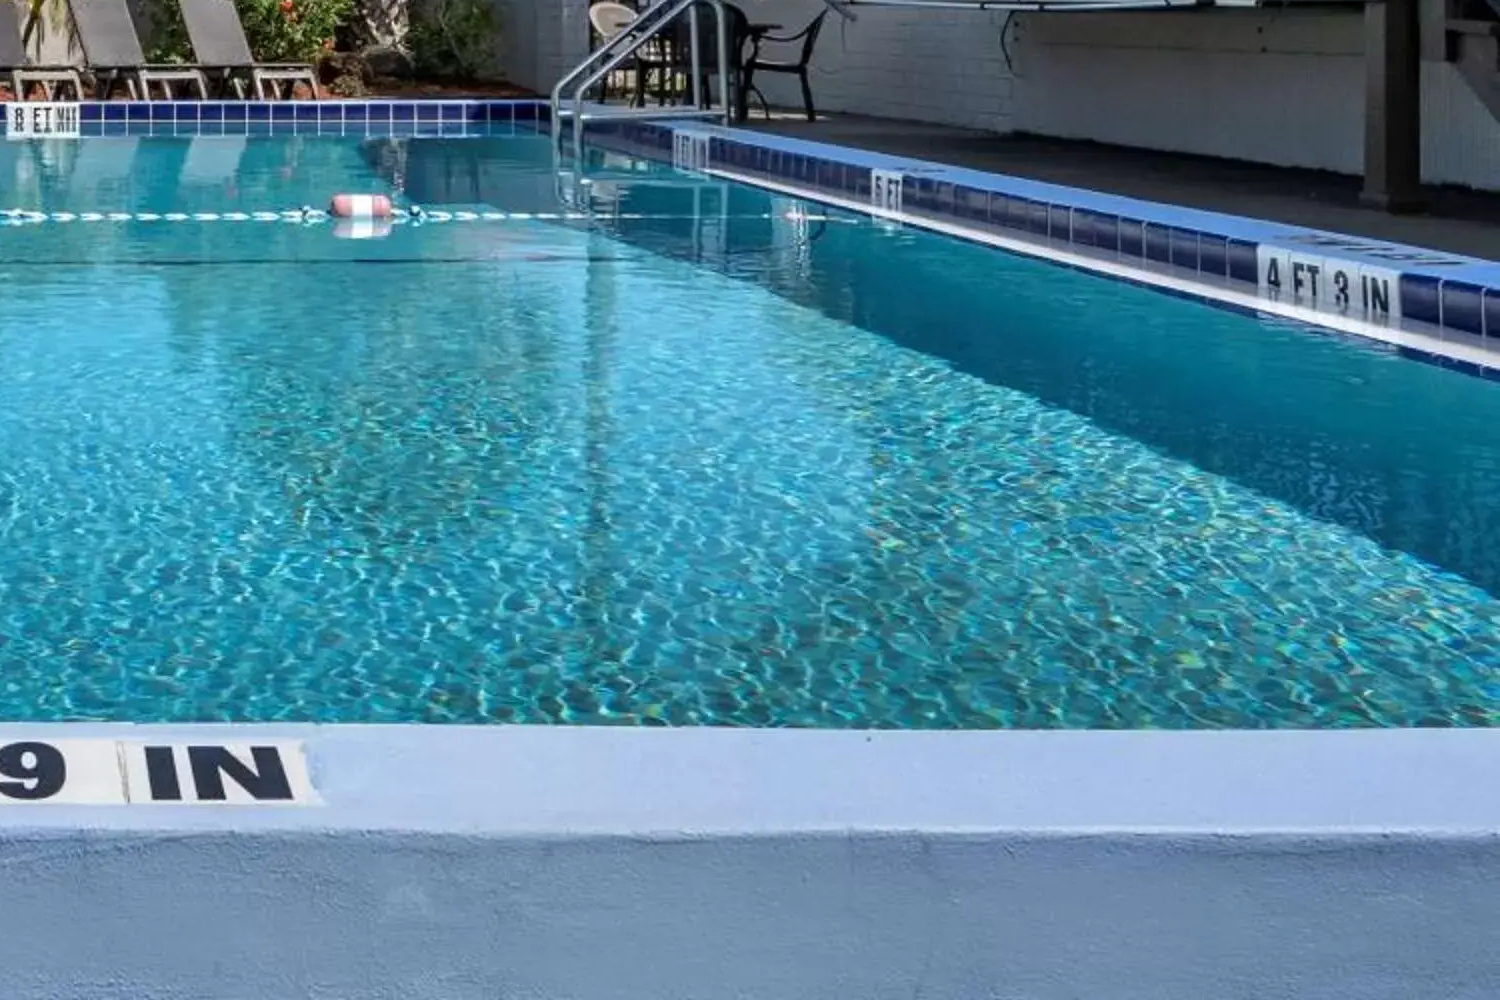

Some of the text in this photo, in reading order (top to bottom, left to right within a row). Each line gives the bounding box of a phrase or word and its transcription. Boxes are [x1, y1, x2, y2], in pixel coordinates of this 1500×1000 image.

[1266, 257, 1389, 314] 4 FT 3 IN
[143, 745, 295, 801] IN
